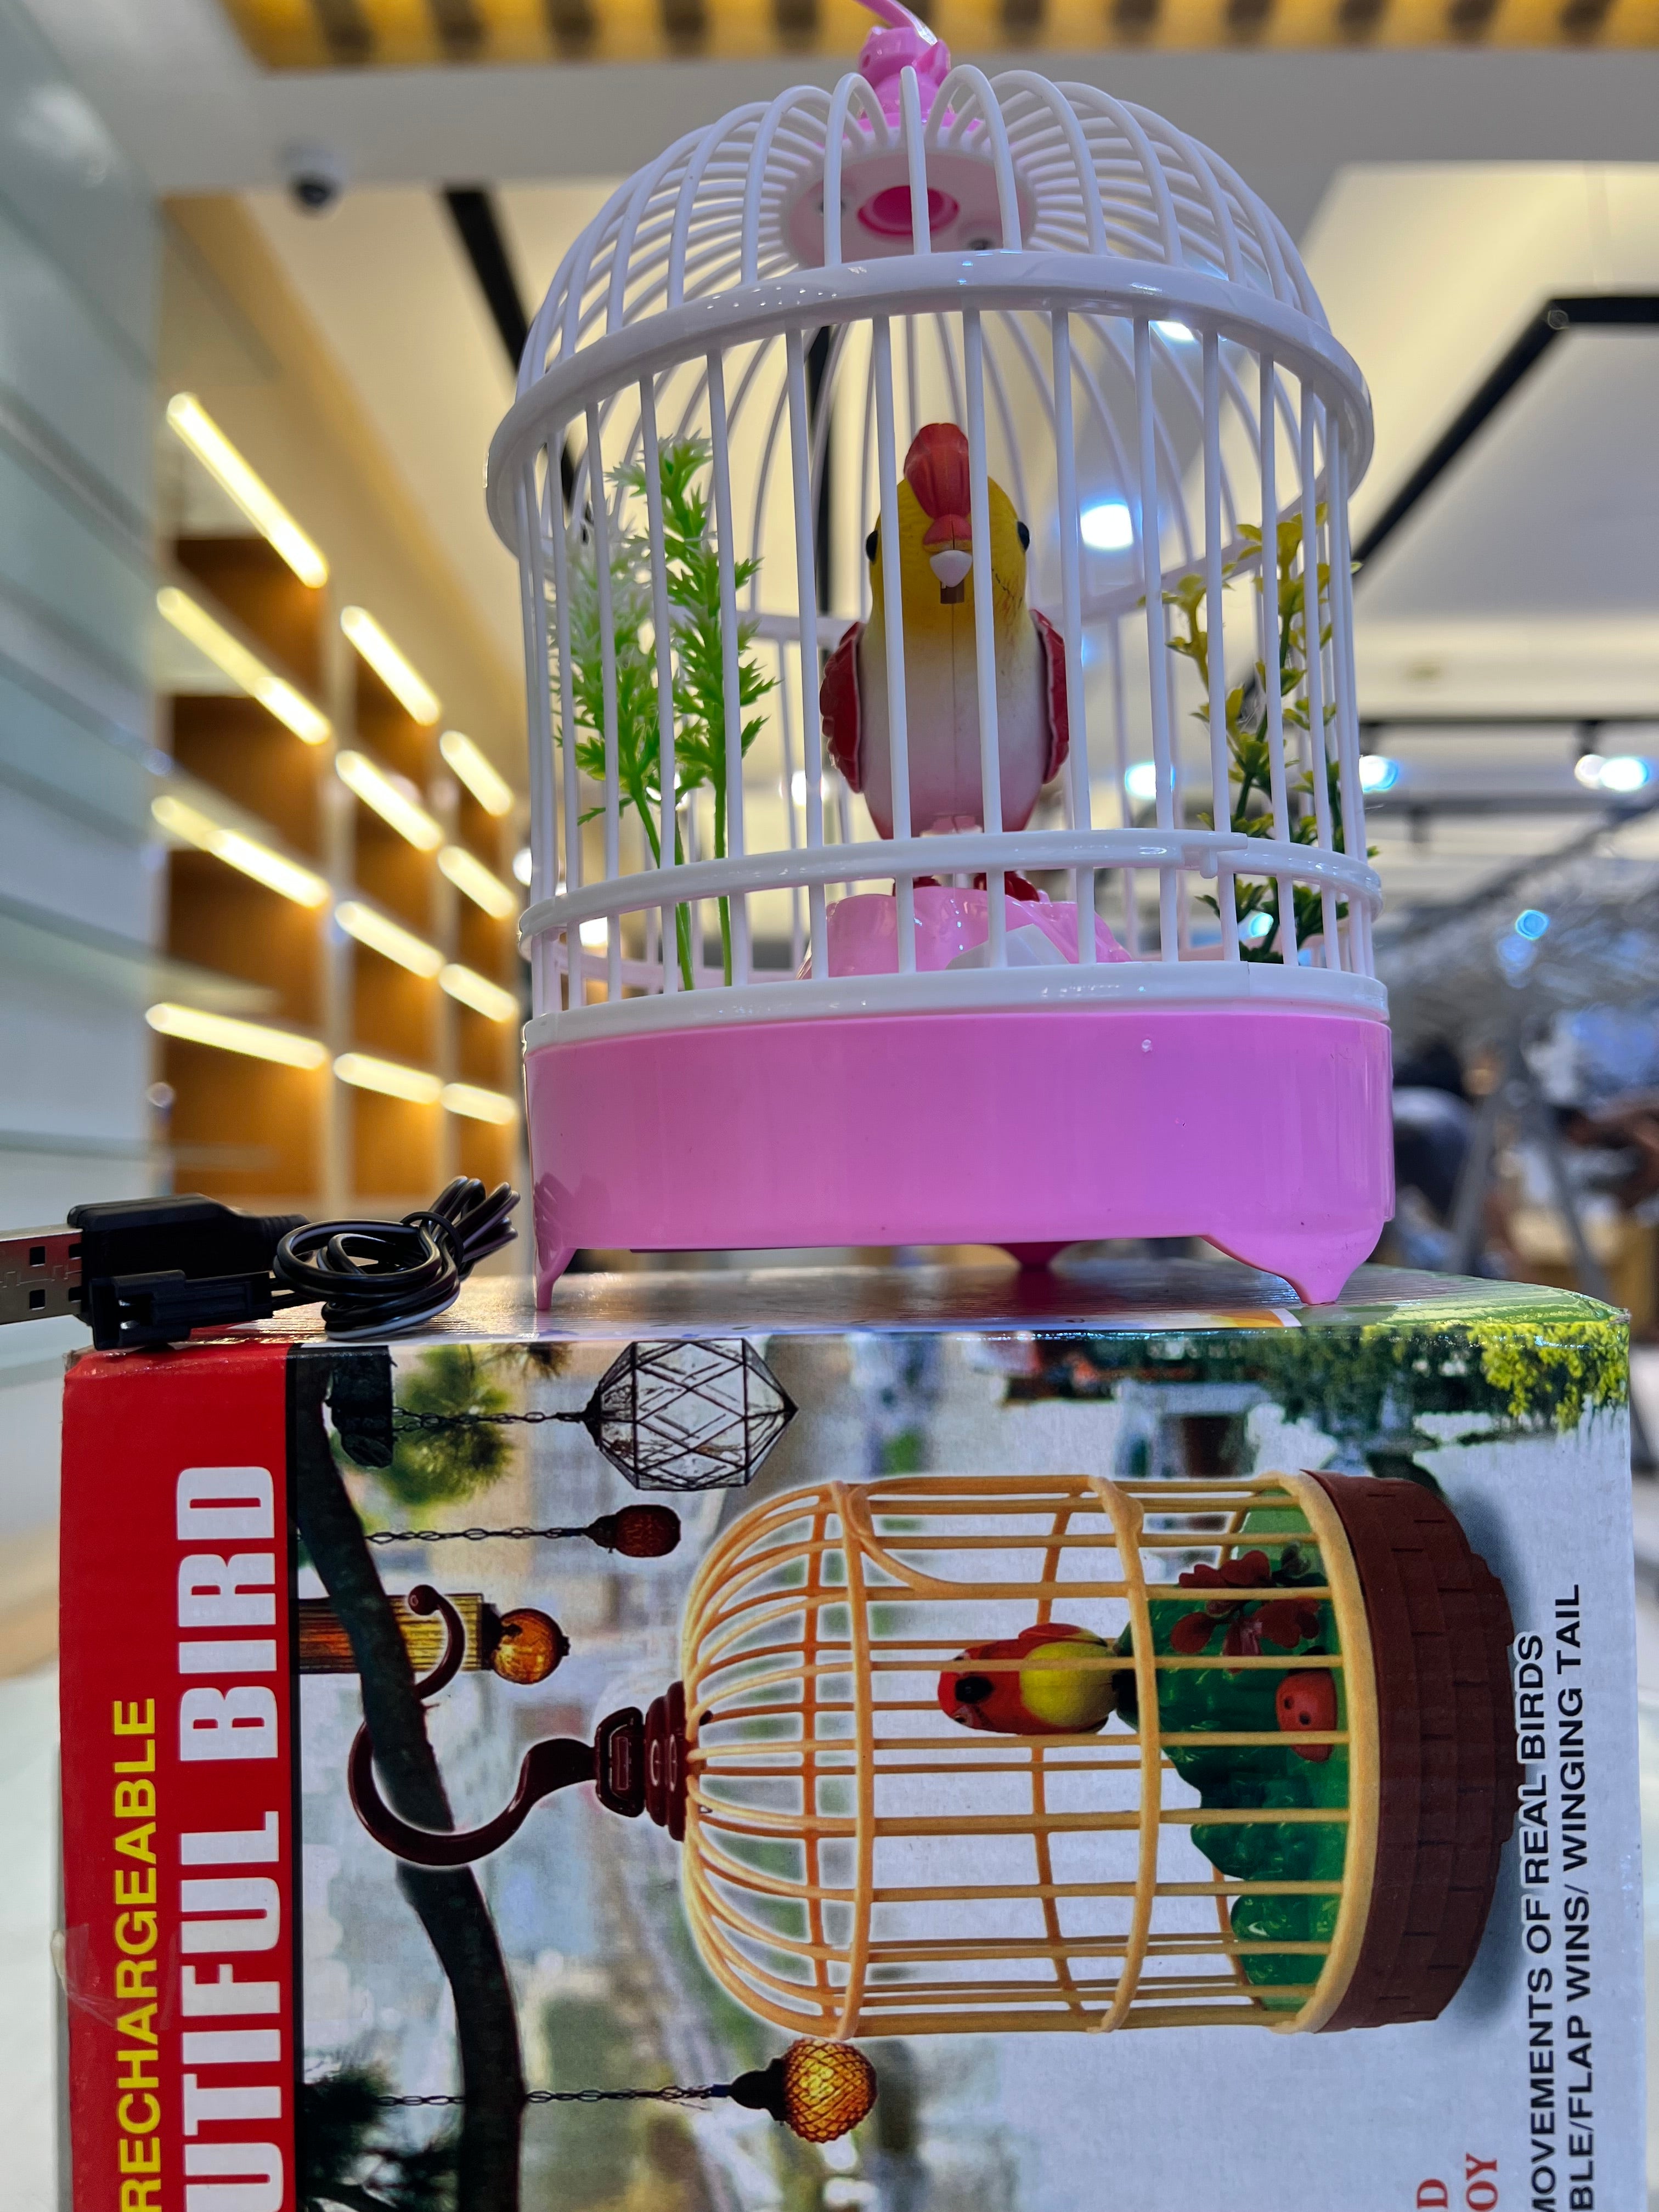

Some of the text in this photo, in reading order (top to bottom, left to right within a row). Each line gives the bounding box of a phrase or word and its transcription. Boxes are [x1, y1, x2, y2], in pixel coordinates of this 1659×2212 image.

[1517, 1635, 1545, 1759] BIRDS
[177, 1466, 283, 2212] UTIFUL BIRD
[1522, 1775, 1549, 1883] REAL
[1526, 1899, 1551, 1954] OF
[1555, 1584, 1593, 2210] BLE/FLAP WINS/ WINGING TAIL
[114, 1699, 161, 2212] RECHARGEABLE
[1417, 2180, 1448, 2208] D
[1466, 2155, 1497, 2212] OY
